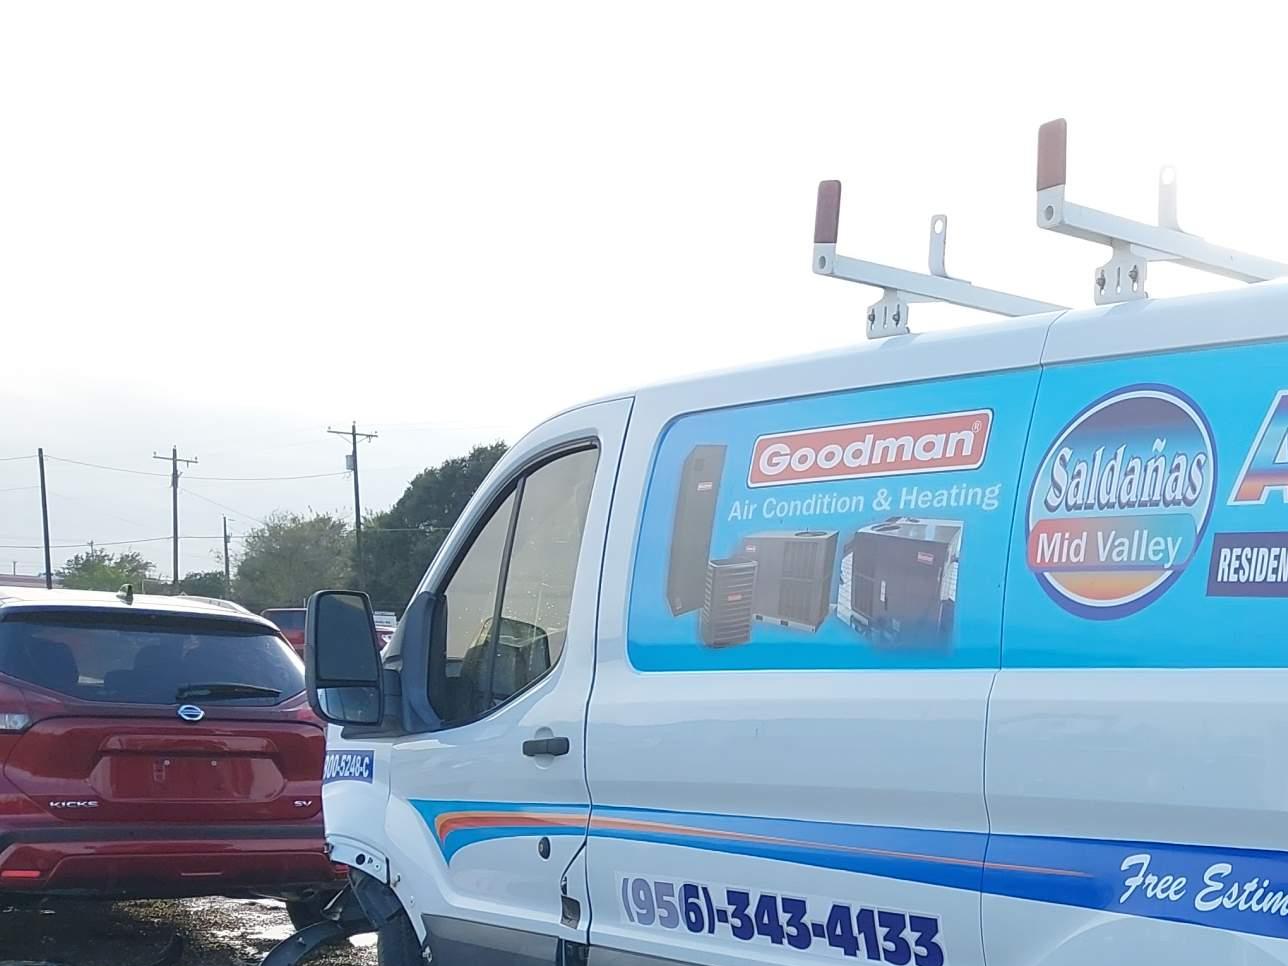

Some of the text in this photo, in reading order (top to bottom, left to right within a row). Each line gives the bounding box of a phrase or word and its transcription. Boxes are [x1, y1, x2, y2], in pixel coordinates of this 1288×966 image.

[1044, 437, 1207, 513] Saldañas
[728, 483, 1001, 521] Air Condition & Heating
[1036, 530, 1182, 569] Mid Valley
[1120, 854, 1187, 904] Free
